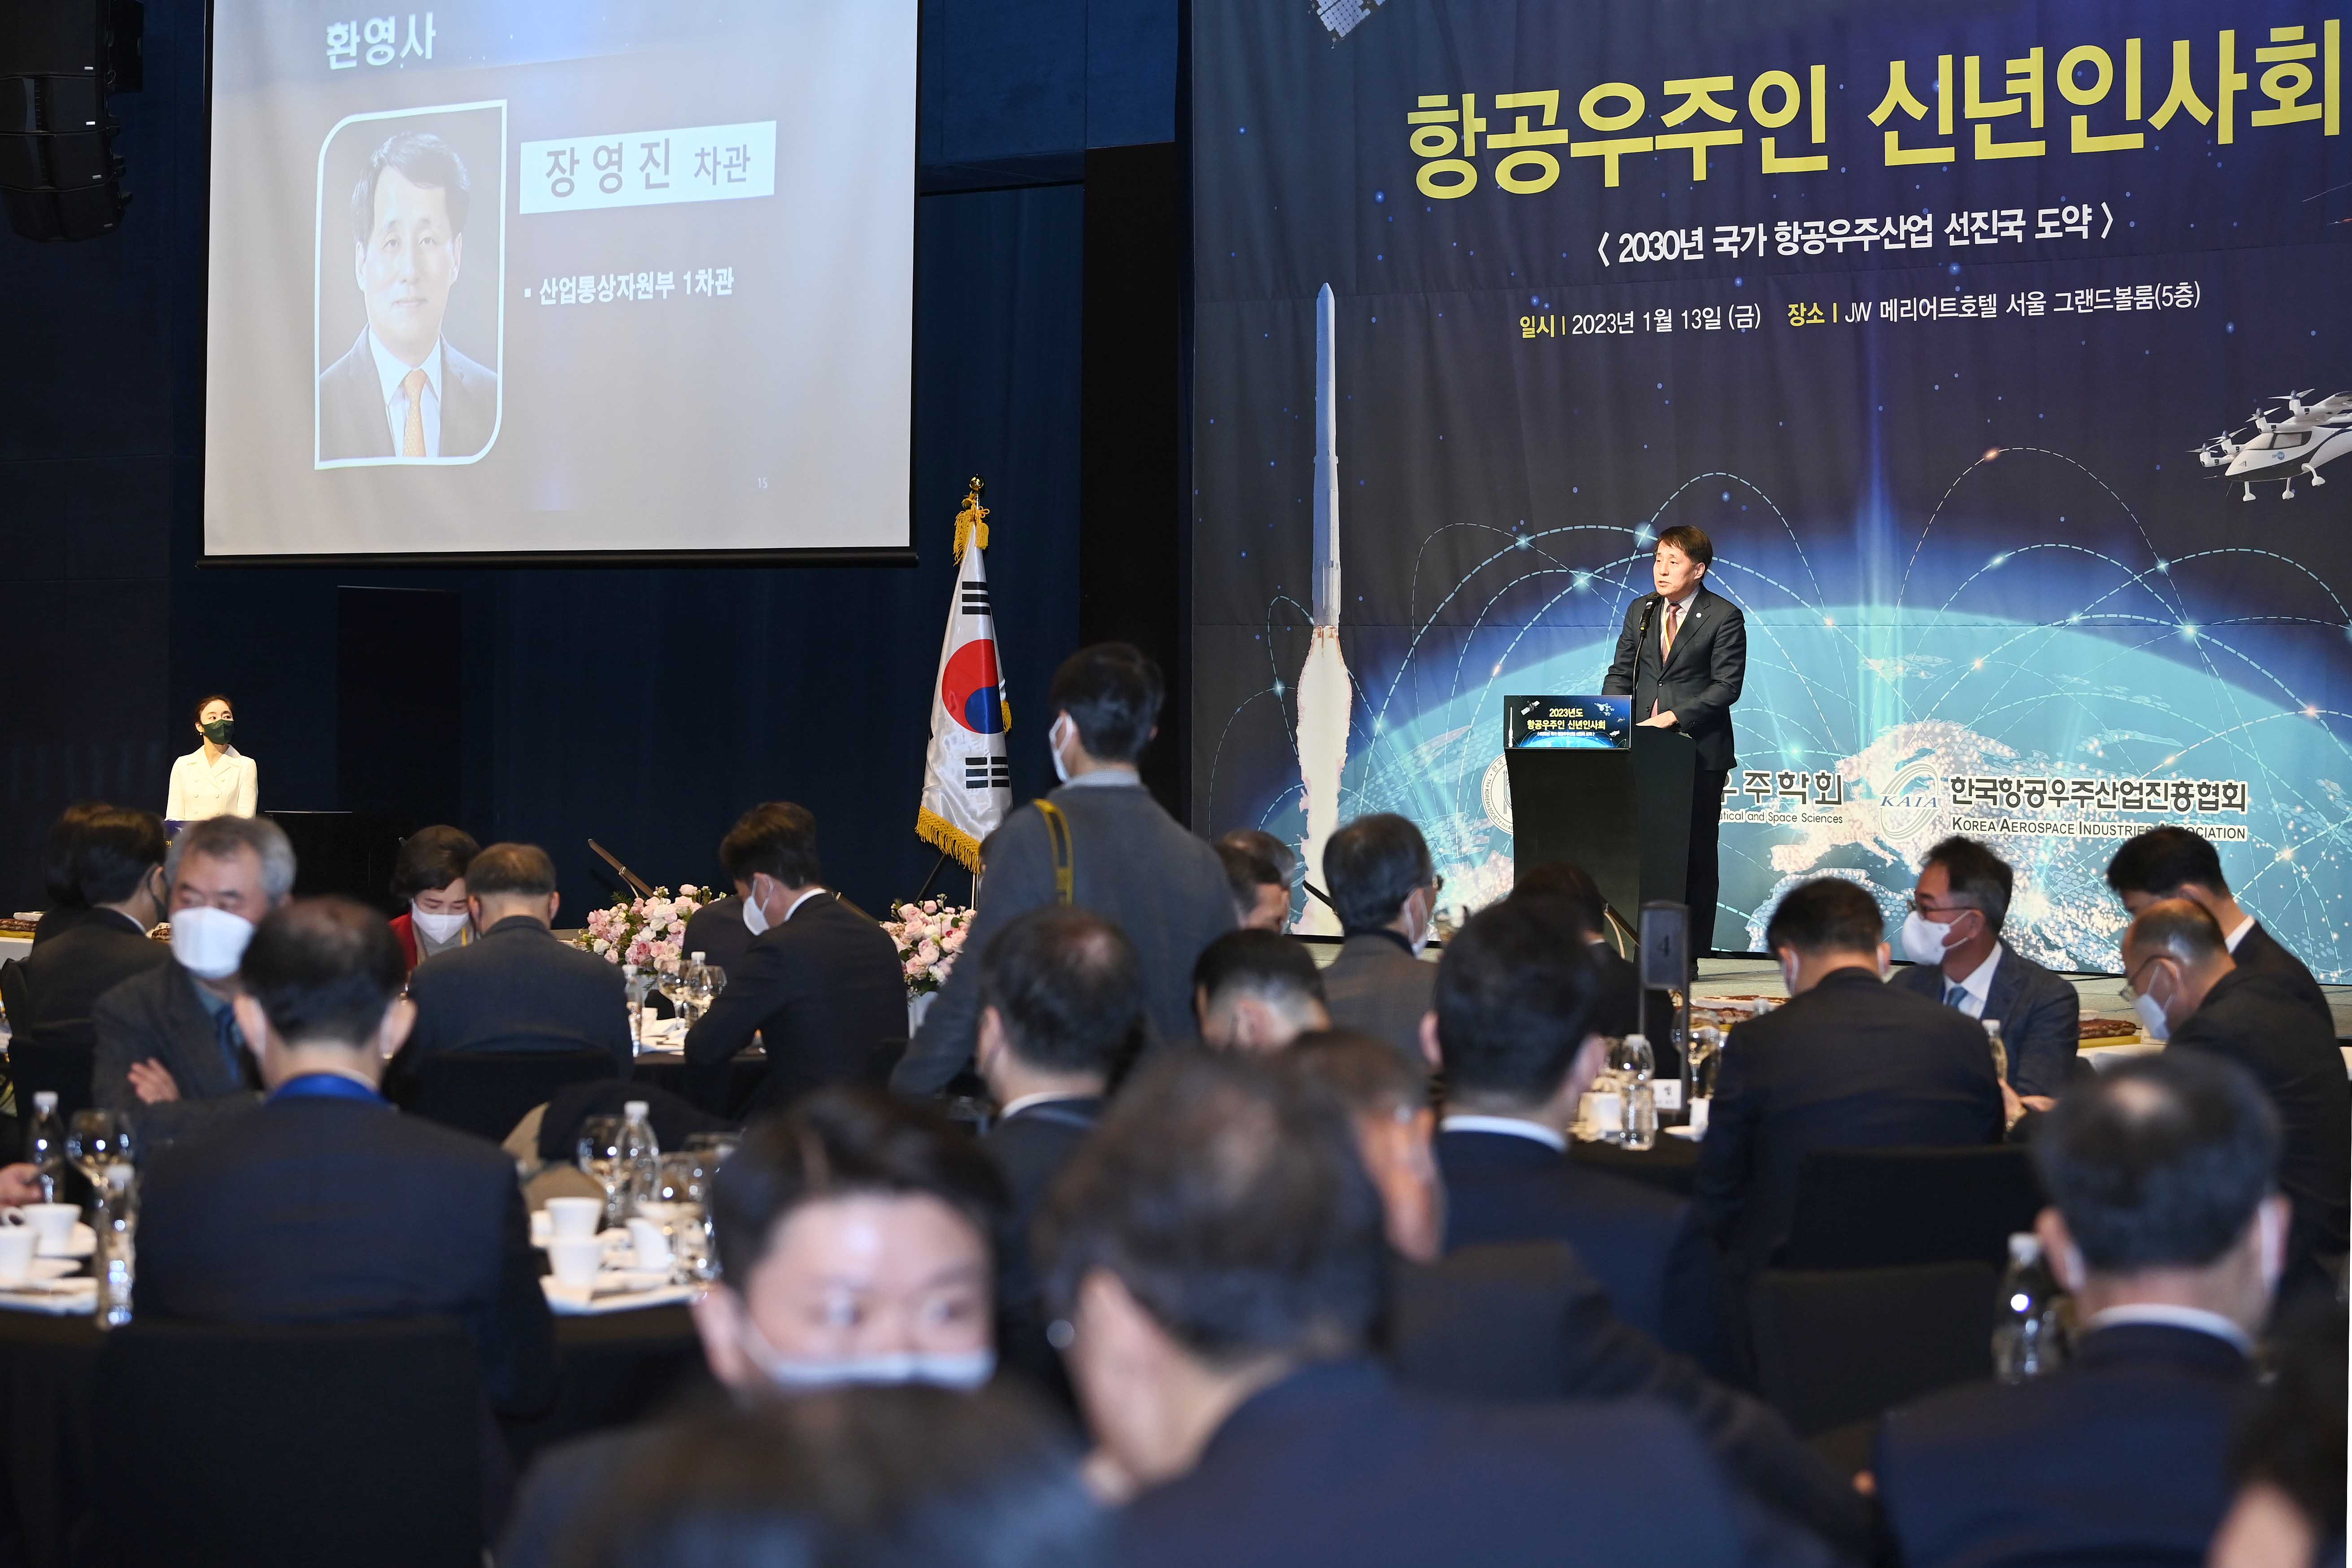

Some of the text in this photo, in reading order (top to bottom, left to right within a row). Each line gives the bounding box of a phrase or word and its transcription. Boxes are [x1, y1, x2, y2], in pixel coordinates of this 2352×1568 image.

[326, 11, 436, 70] 환영사
[1408, 20, 2340, 199] 항공우주인 신년인사회
[694, 144, 750, 186] 차관
[1619, 226, 1704, 263] 2030년
[1713, 223, 1767, 258] 국가
[1774, 213, 1932, 256] 항공우주산업
[1944, 209, 2026, 246] 선진국
[2035, 204, 2092, 239] 도약
[539, 266, 735, 305] 산업통상자원부 1차관
[1521, 280, 2201, 338] 일시 2023년 1월 13일 (금) 장소 JW 메리어트호텔 서울 그랜드볼룸(5층)
[758, 477, 767, 488] 15
[1527, 719, 1606, 730] 항공우주인 신년인사회
[1549, 708, 1583, 718] 2023년도
[1880, 796, 1938, 808] KAIA
[1950, 777, 2246, 812] 한국항공우주산업진흥협회
[1488, 807, 1503, 826] SOCIETY
[1747, 812, 1764, 821] and
[1768, 812, 1797, 823] Space
[1801, 813, 1843, 823] Sciences
[1952, 817, 1996, 832] KOREA
[1999, 819, 2075, 834] AEROSPACE
